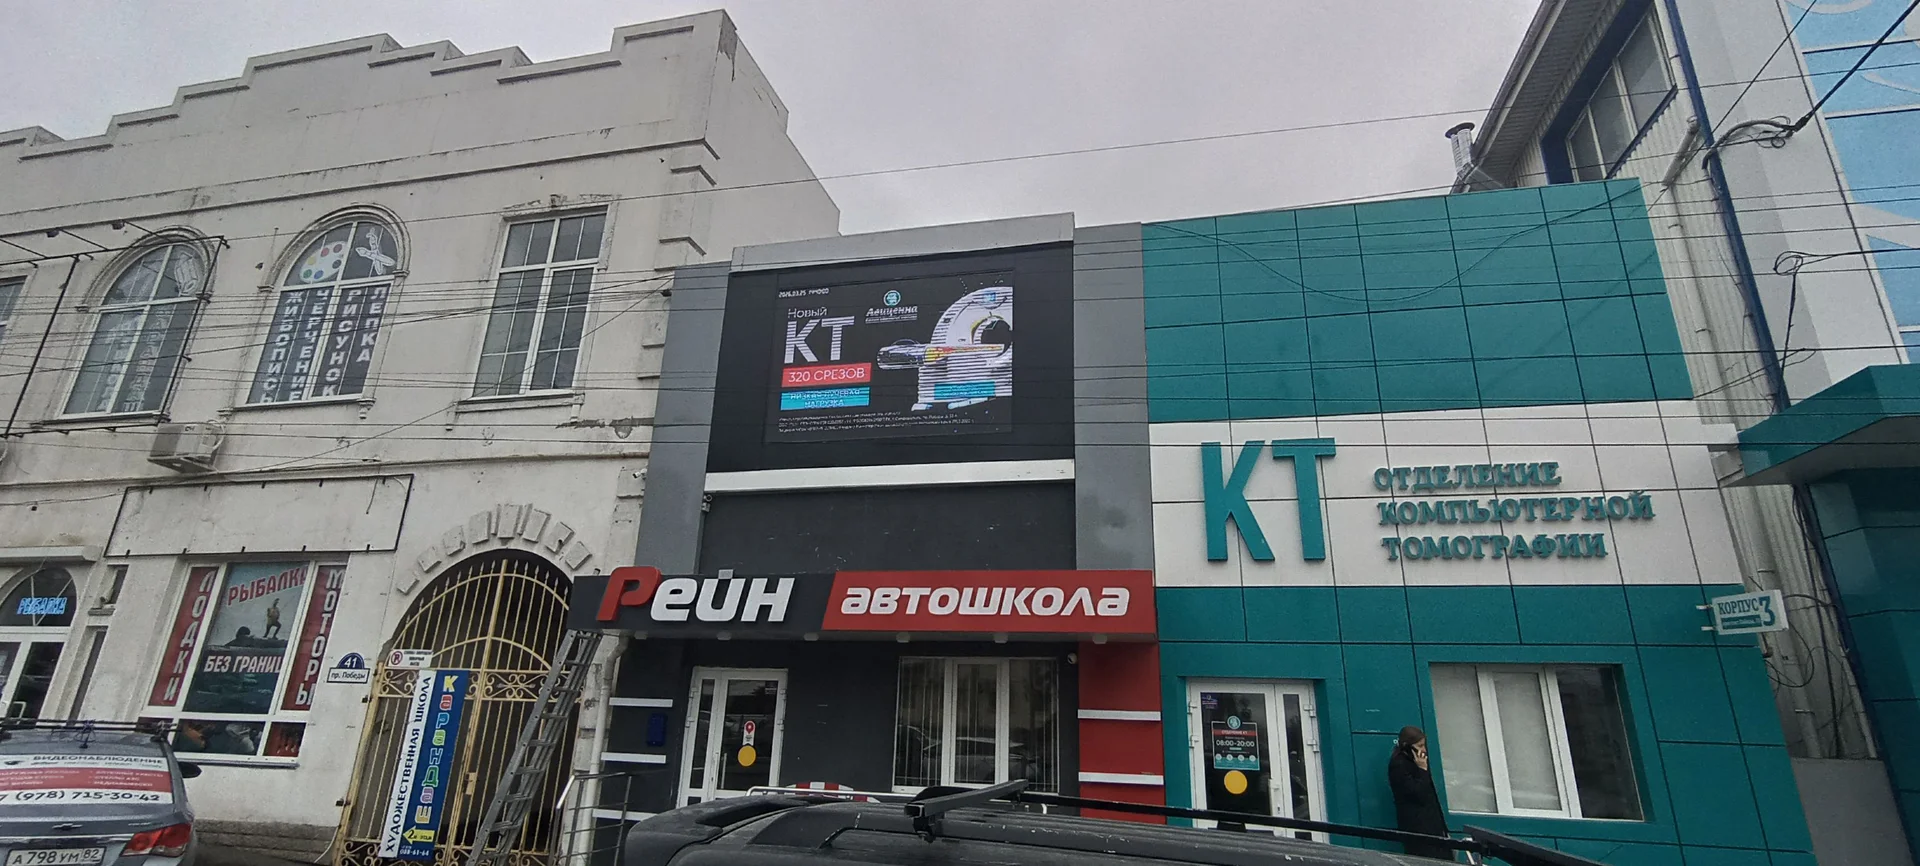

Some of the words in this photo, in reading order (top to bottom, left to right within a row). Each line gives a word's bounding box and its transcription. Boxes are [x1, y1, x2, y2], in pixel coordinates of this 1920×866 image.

[356, 286, 389, 363] ЛЕПКА
[788, 306, 828, 318] Новый
[260, 291, 304, 403] ЖИВОПИСЬ
[288, 289, 331, 401] ЧЕРЧЕНИЕ
[322, 289, 362, 397] РИСУНОК
[784, 315, 855, 364] КТ
[788, 371, 811, 383] 320
[813, 367, 865, 381] СРЕЗОВ
[1373, 461, 1562, 492] ОТДЕЛЕНИЕ
[1201, 437, 1336, 562] КТ
[1377, 490, 1655, 527] КОМПЬЮТЕРНОЙ
[1382, 533, 1608, 561] ТОМОГРАФИИ
[840, 586, 1131, 618] автошкола
[1717, 598, 1759, 615] КОРПУС
[1758, 595, 1776, 627] 3
[164, 570, 216, 701] ЛОДКИ
[295, 568, 346, 706] МОТОРЫ
[203, 655, 231, 673] БЕЗ
[330, 672, 341, 680] пр.
[342, 671, 366, 681] Победы
[343, 656, 358, 669] 41
[1216, 739, 1255, 747] 08:00-20:00
[33, 755, 164, 764] ВИДЕОНАБЛЮДЕНИЕ
[386, 728, 420, 852] ХУДОЖЕСТВЕННАЯ
[414, 676, 432, 723] ШКОЛА
[16, 790, 65, 801] (978)
[72, 791, 160, 802] 715-30-42
[83, 849, 100, 860] 82
